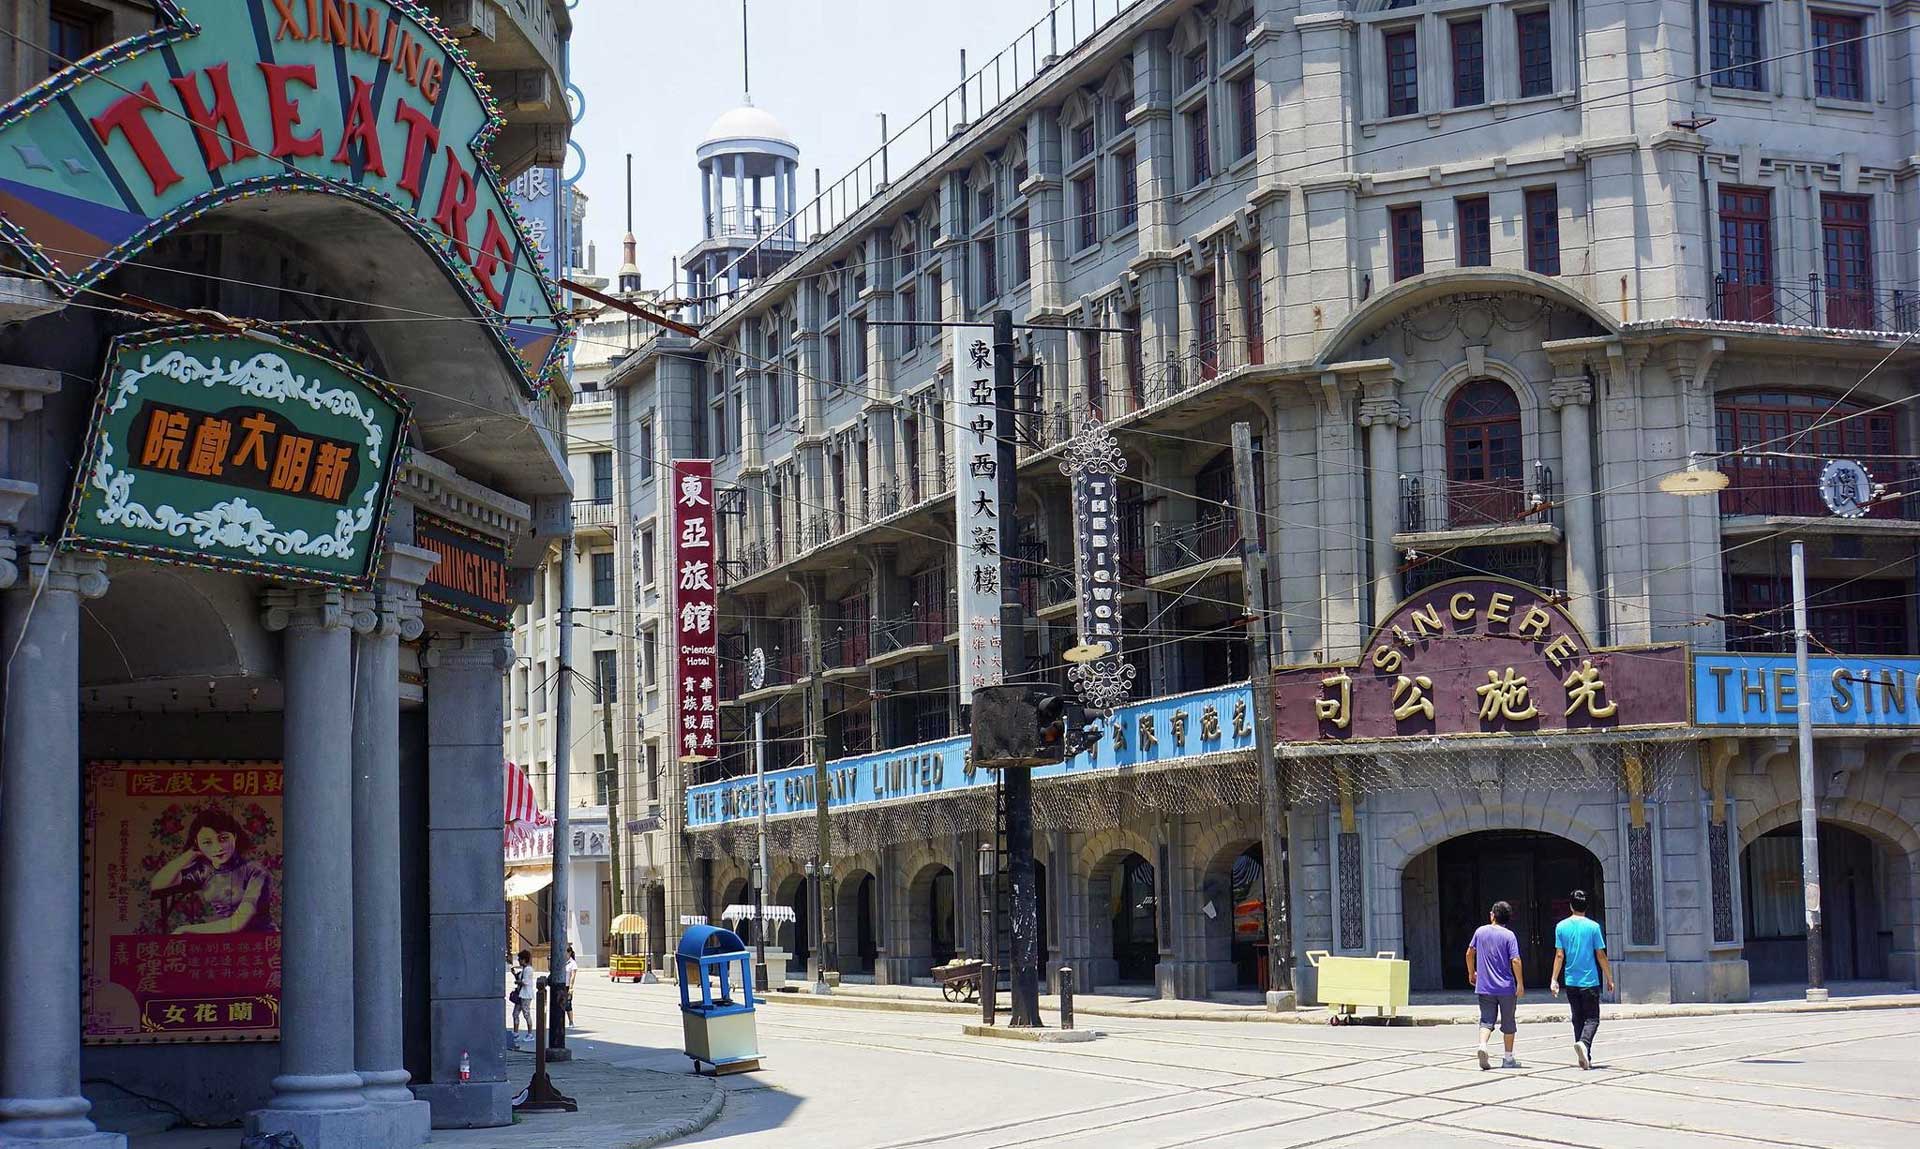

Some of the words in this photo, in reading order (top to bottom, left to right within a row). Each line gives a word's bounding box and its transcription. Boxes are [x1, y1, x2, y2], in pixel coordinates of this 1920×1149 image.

[274, 0, 443, 105] XINMING
[90, 61, 515, 312] THEATRE
[678, 473, 714, 635] 東亞旅館
[686, 656, 710, 667] Hotel
[1373, 592, 1578, 673] SINCERE
[1709, 667, 1799, 713] THE
[693, 790, 716, 819] THE
[721, 781, 777, 817] SINCEE
[784, 767, 857, 806] COMANY
[873, 752, 943, 794] LIMITED
